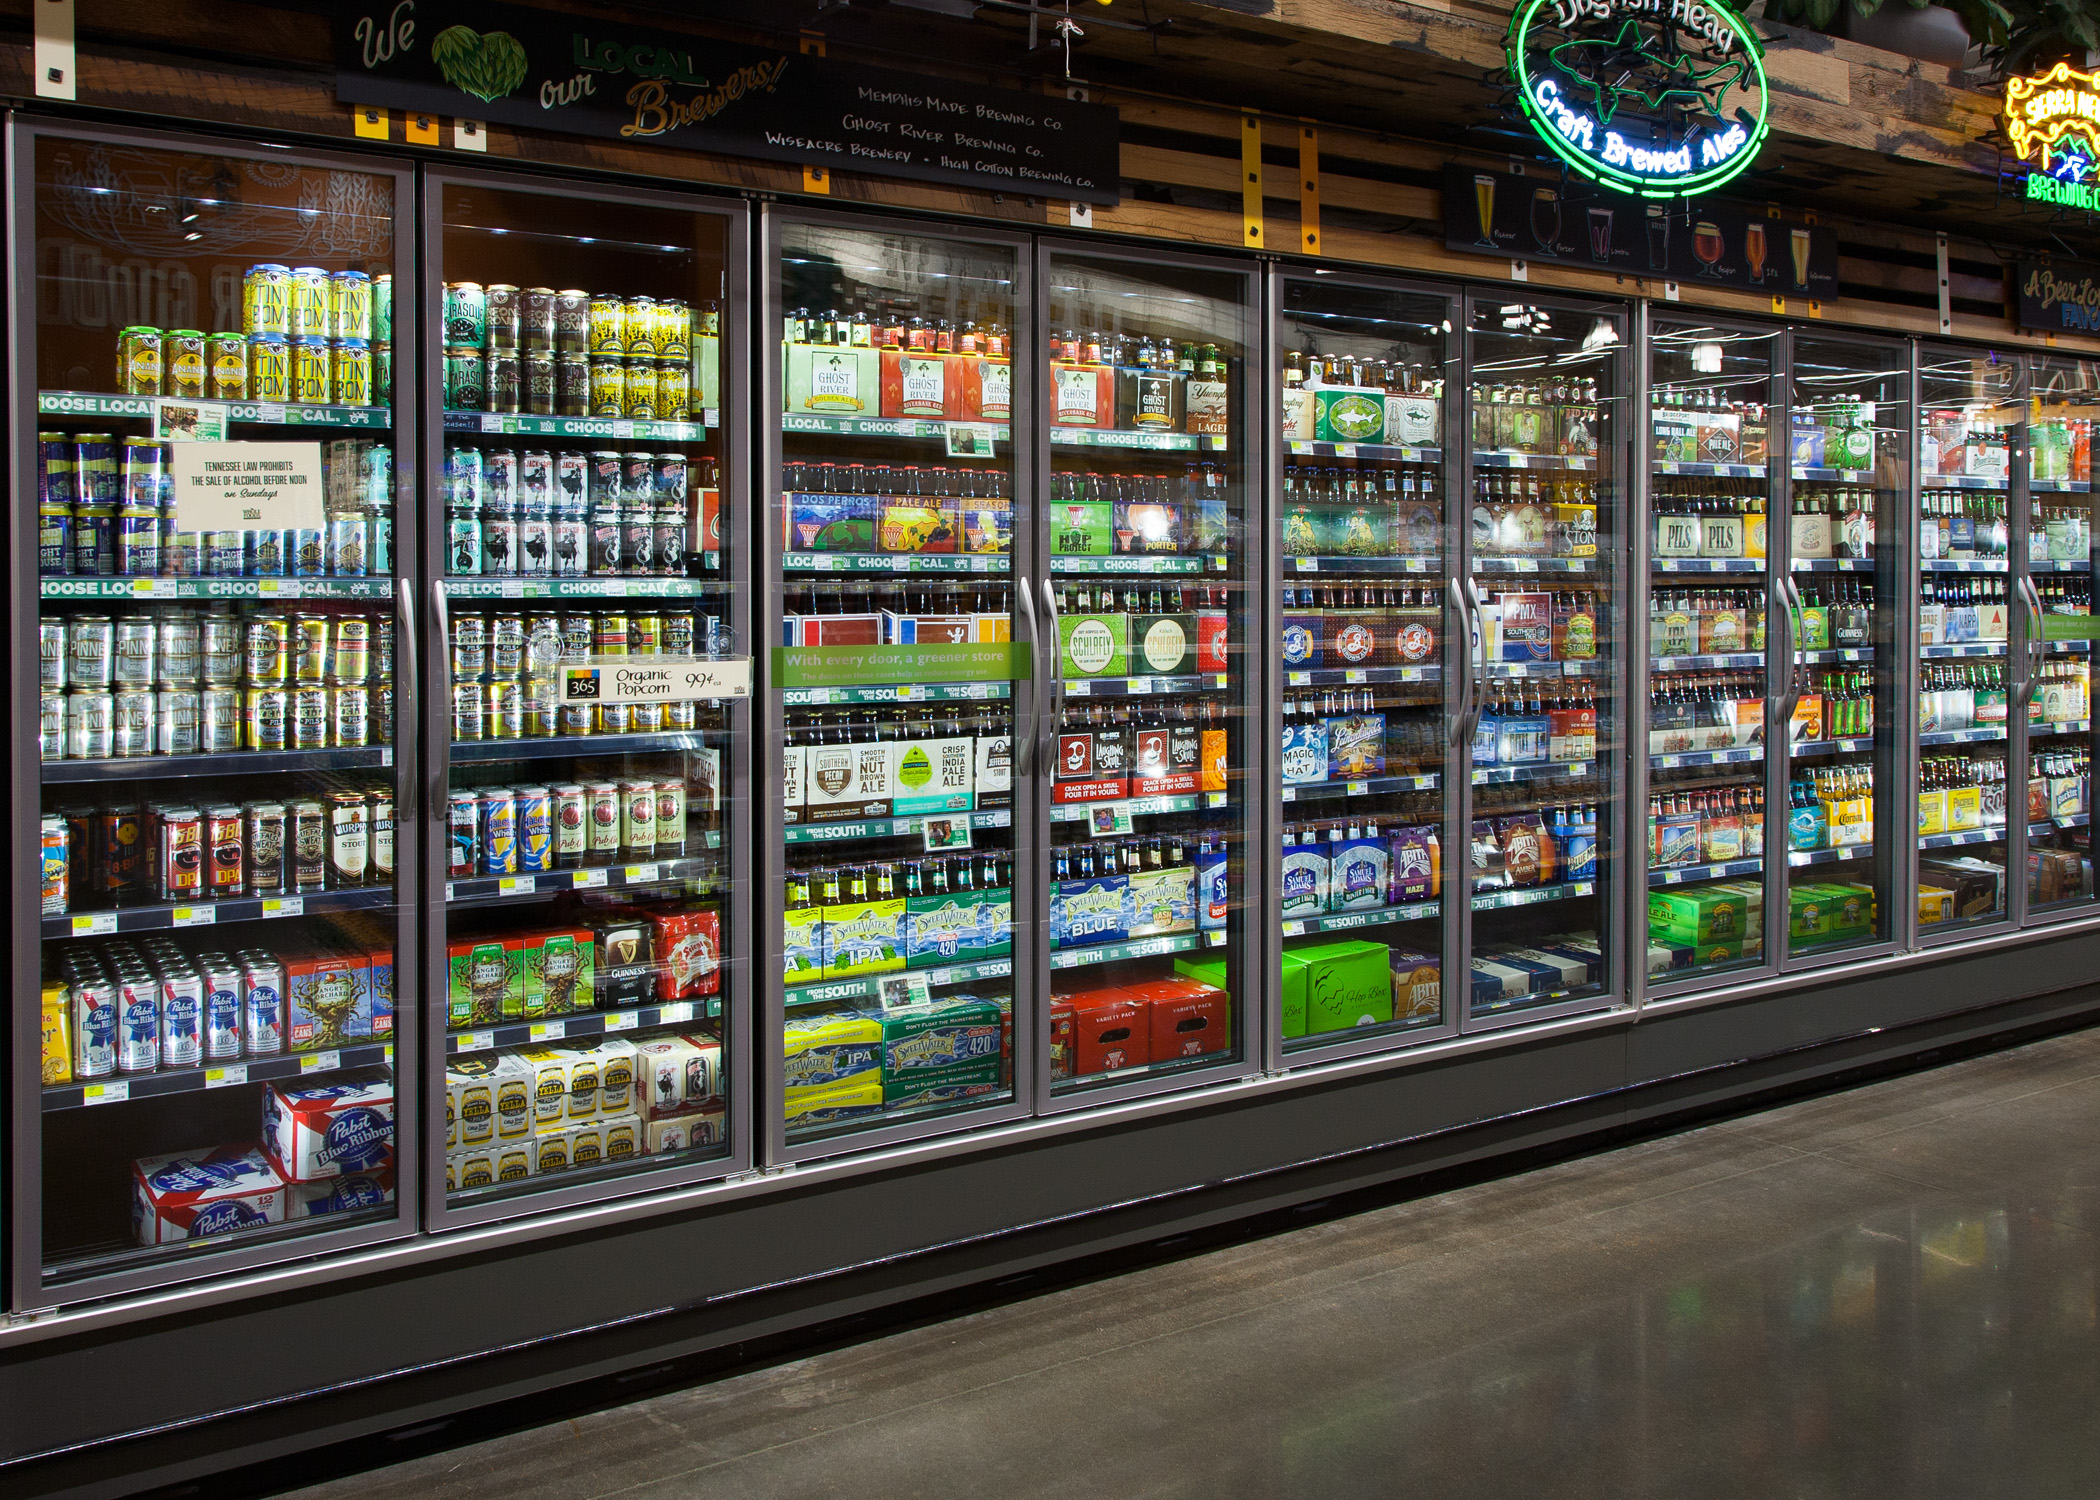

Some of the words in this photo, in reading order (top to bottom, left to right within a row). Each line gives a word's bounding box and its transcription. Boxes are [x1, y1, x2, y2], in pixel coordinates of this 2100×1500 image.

[354, 0, 415, 68] We
[573, 34, 709, 86] LOCAL
[540, 74, 596, 109] our
[620, 57, 788, 136] Brewers!
[2026, 89, 2076, 125] SIERRA
[1536, 80, 1593, 150] Craft
[1602, 132, 1690, 172] Brewed
[1702, 124, 1746, 166] Ales
[2027, 173, 2092, 209] BREWING
[257, 284, 290, 306] TINY
[2024, 270, 2040, 297] A
[2040, 271, 2077, 309] Beer
[2077, 279, 2100, 321] Lo
[819, 373, 851, 384] GHOST
[909, 379, 938, 389] GHOST
[820, 385, 848, 394] RIVER
[910, 391, 936, 399] RIVER
[1098, 433, 1138, 444] CHOOSE
[204, 461, 241, 471] TENNESSEE
[243, 461, 258, 471] LAW
[259, 461, 293, 471] PROHIBITS
[191, 476, 203, 485] THE
[206, 476, 221, 485] SALE
[223, 475, 232, 485] OF
[233, 475, 262, 485] ALCOHOL
[263, 475, 287, 484] BEFORE
[289, 475, 308, 484] NOON
[239, 488, 278, 500] Sundays
[802, 495, 826, 505] DOS
[830, 496, 869, 506] PERROS
[896, 498, 922, 507] PALE
[925, 499, 941, 507] ALE
[1668, 525, 1691, 548] PILS
[1708, 526, 1733, 548] PILS
[1146, 542, 1177, 551] PORTER
[1513, 604, 1536, 619] PMX
[1838, 628, 1863, 638] GUINNESS
[1073, 636, 1111, 656] SCHLAFLY
[786, 654, 821, 666] With
[827, 655, 863, 667] every
[869, 653, 902, 666] door,
[906, 655, 913, 663] a
[918, 652, 968, 666] greener
[972, 651, 1003, 662] store
[571, 680, 595, 694] 365
[616, 669, 672, 682] Organic
[801, 673, 817, 681] The
[818, 672, 840, 680] doors
[897, 670, 913, 678] help
[618, 683, 670, 695] Popcorn
[1096, 743, 1123, 758] LAUGHING
[1284, 749, 1313, 763] MAGIC
[820, 757, 848, 768] SOUTHERN
[860, 762, 885, 773] NUT
[943, 758, 965, 767] INDIA
[1100, 756, 1121, 769] SKULL
[943, 767, 965, 775] PALE
[1287, 764, 1310, 774] HAT
[861, 781, 885, 793] ALE
[943, 776, 965, 786] ALE
[1839, 811, 1863, 825] Corona
[825, 825, 866, 838] SOUTH
[1844, 826, 1858, 837] Light
[1401, 849, 1429, 866] ABITA
[1350, 865, 1373, 875] SAMUEL
[1515, 865, 1536, 875] AMBER
[1351, 873, 1372, 883] ADAMS
[1405, 884, 1425, 894] HAZE
[1072, 916, 1117, 937] BLUE
[1337, 916, 1365, 927] SOUTH
[940, 941, 956, 955] 420
[850, 946, 885, 966] IPA
[612, 968, 646, 978] GUINNESS
[316, 991, 348, 999] ORCHARD
[319, 985, 344, 994] ANGRY
[825, 983, 866, 997] SOUTH
[1346, 989, 1366, 1003] Hop
[1368, 985, 1386, 998] Box
[1096, 1014, 1119, 1023] VARIETY
[970, 1037, 991, 1054] 420
[499, 1100, 526, 1110] YELLA
[331, 1113, 370, 1142] Pabst
[318, 1136, 348, 1166] Blue
[349, 1125, 394, 1149] Ribbon
[257, 1195, 273, 1204] 12
[199, 1208, 238, 1235] Pabst
